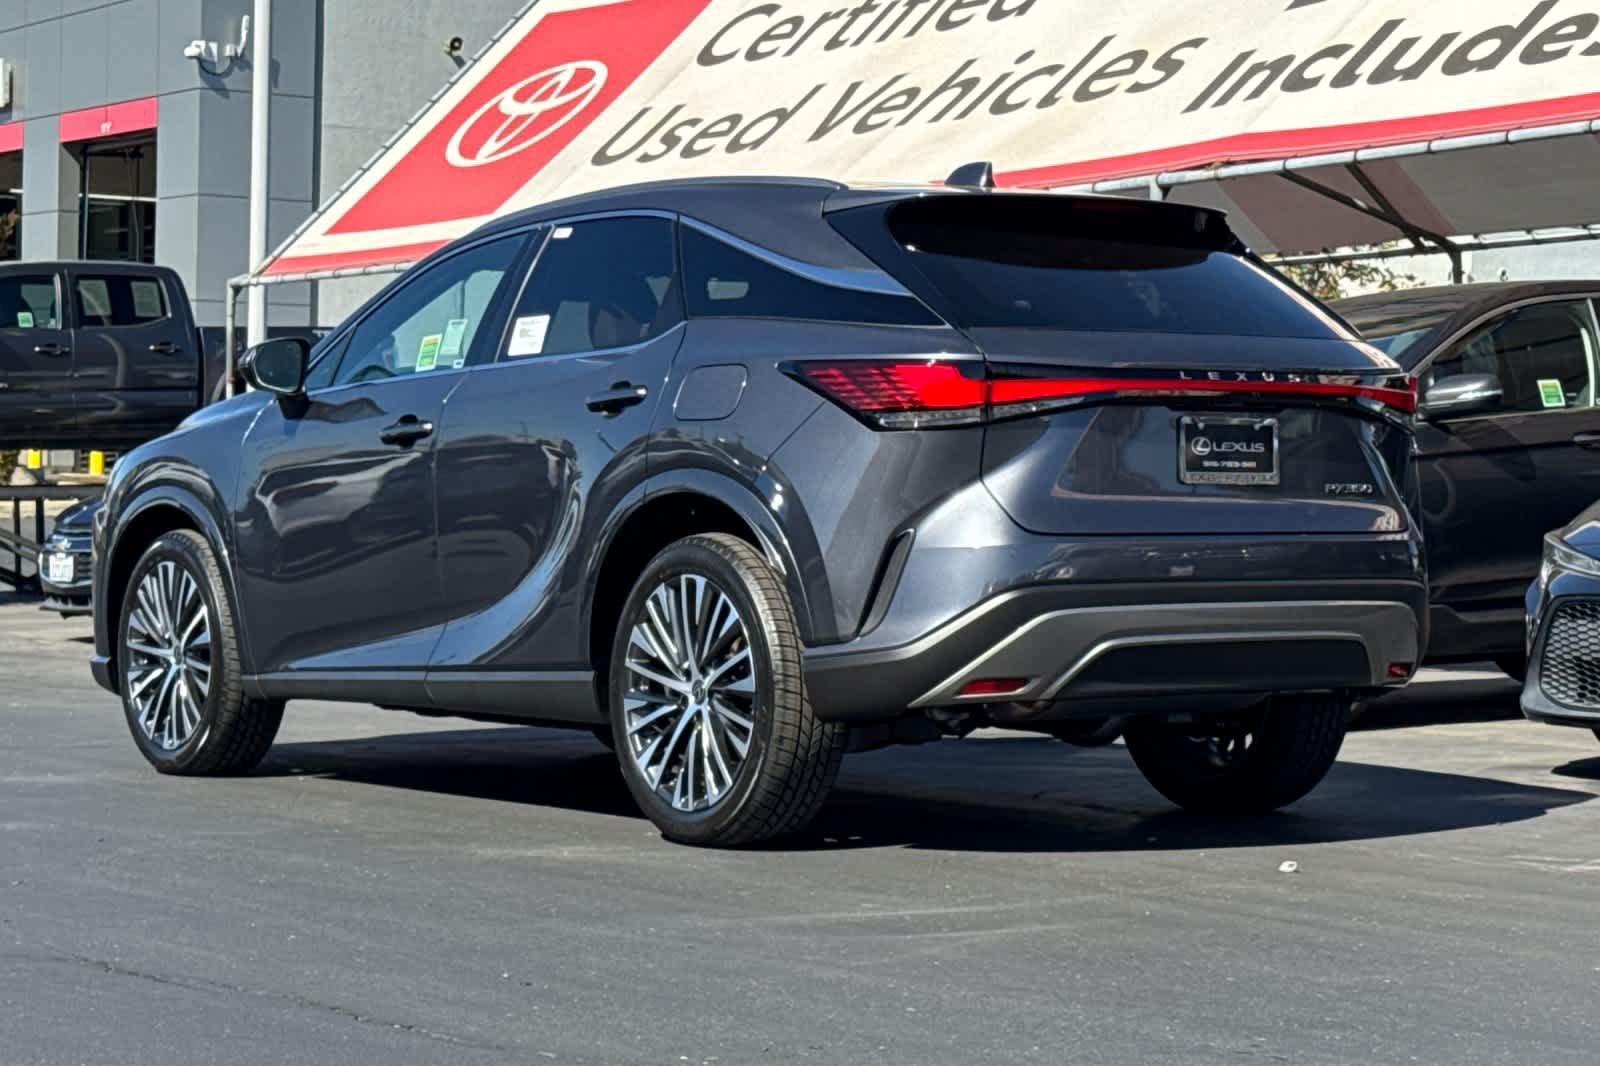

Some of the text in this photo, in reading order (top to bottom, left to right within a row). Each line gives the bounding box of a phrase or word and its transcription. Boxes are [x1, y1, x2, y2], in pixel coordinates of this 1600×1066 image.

[1181, 0, 1600, 114] Include
[591, 35, 1210, 167] Used Vehicles
[1179, 370, 1301, 383] LEXUS
[1213, 441, 1265, 453] LEXUS
